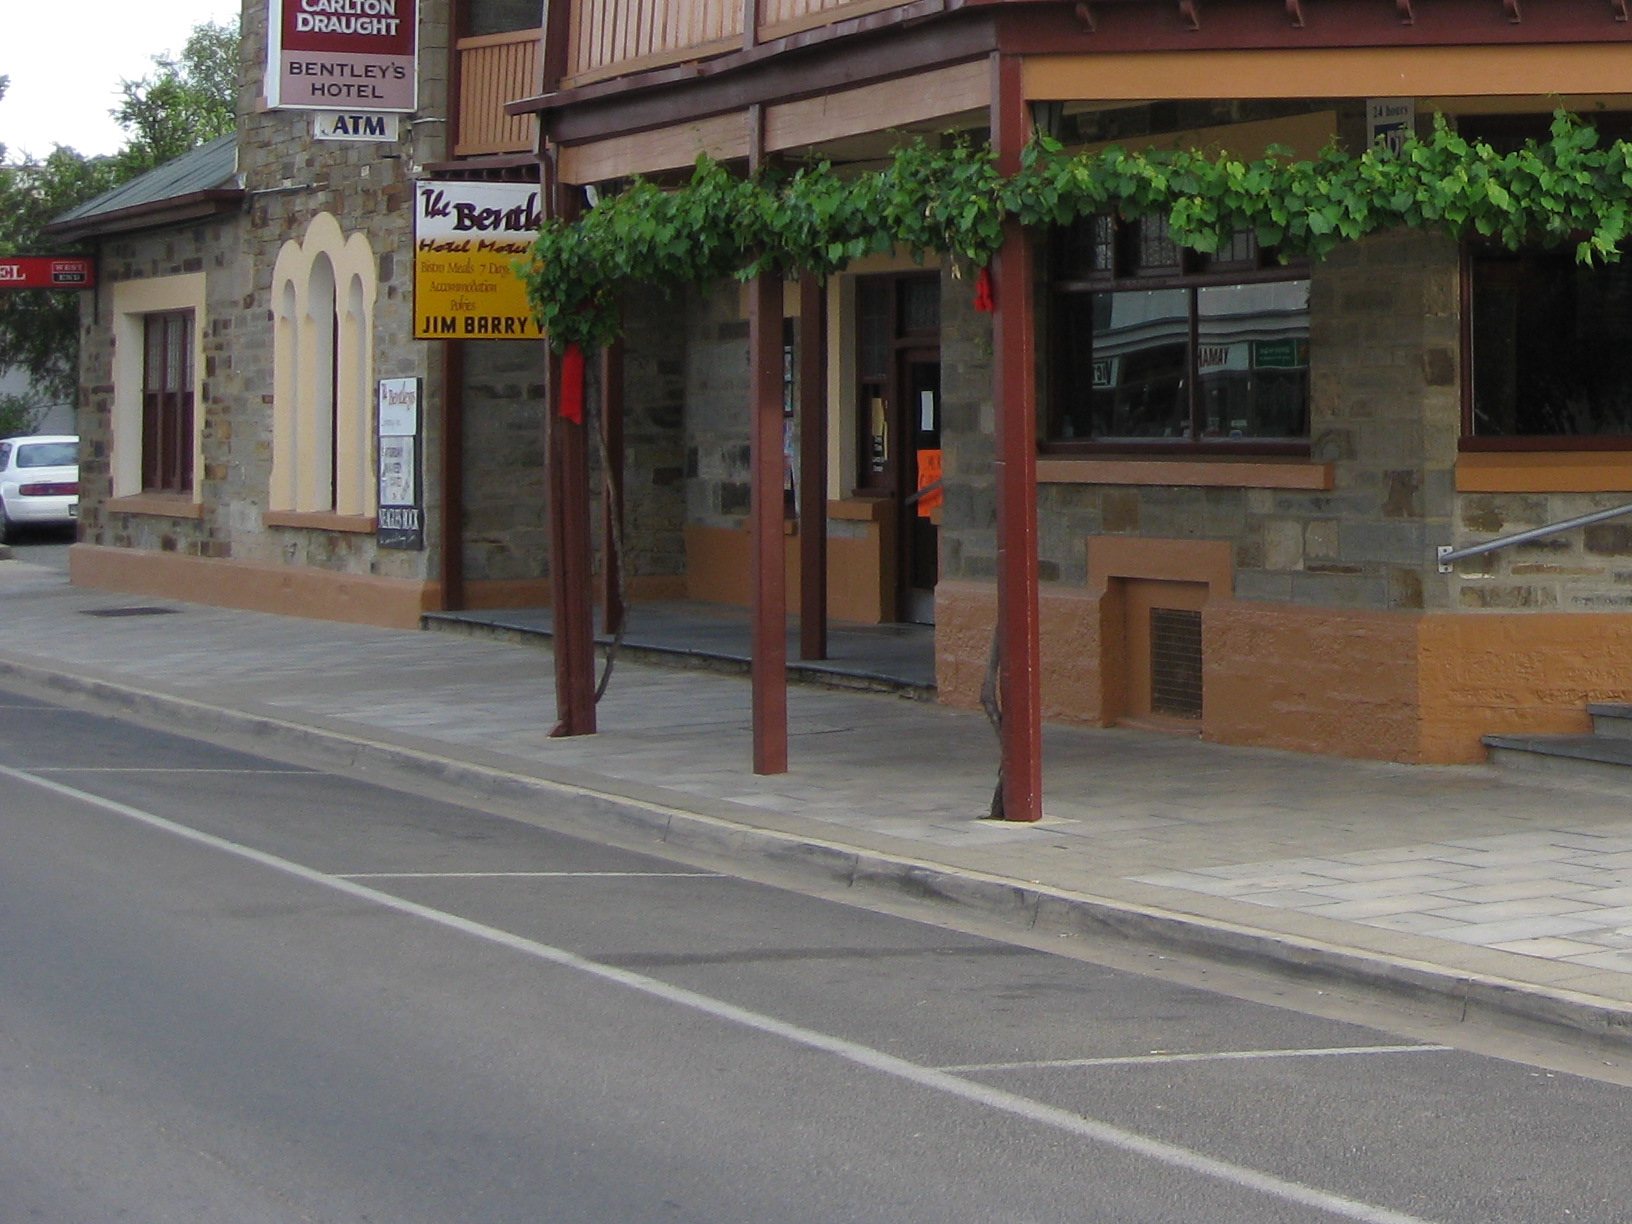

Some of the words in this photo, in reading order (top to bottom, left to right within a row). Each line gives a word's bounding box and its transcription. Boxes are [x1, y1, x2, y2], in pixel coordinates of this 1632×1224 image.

[296, 13, 400, 37] DRAUGHT
[289, 61, 406, 79] BENTLEY'S
[311, 83, 384, 99] HOTEL
[331, 115, 386, 137] ATM
[420, 188, 451, 219] The
[419, 239, 471, 254] Hotel
[422, 316, 457, 334] JIM
[464, 316, 528, 334] BARRY
